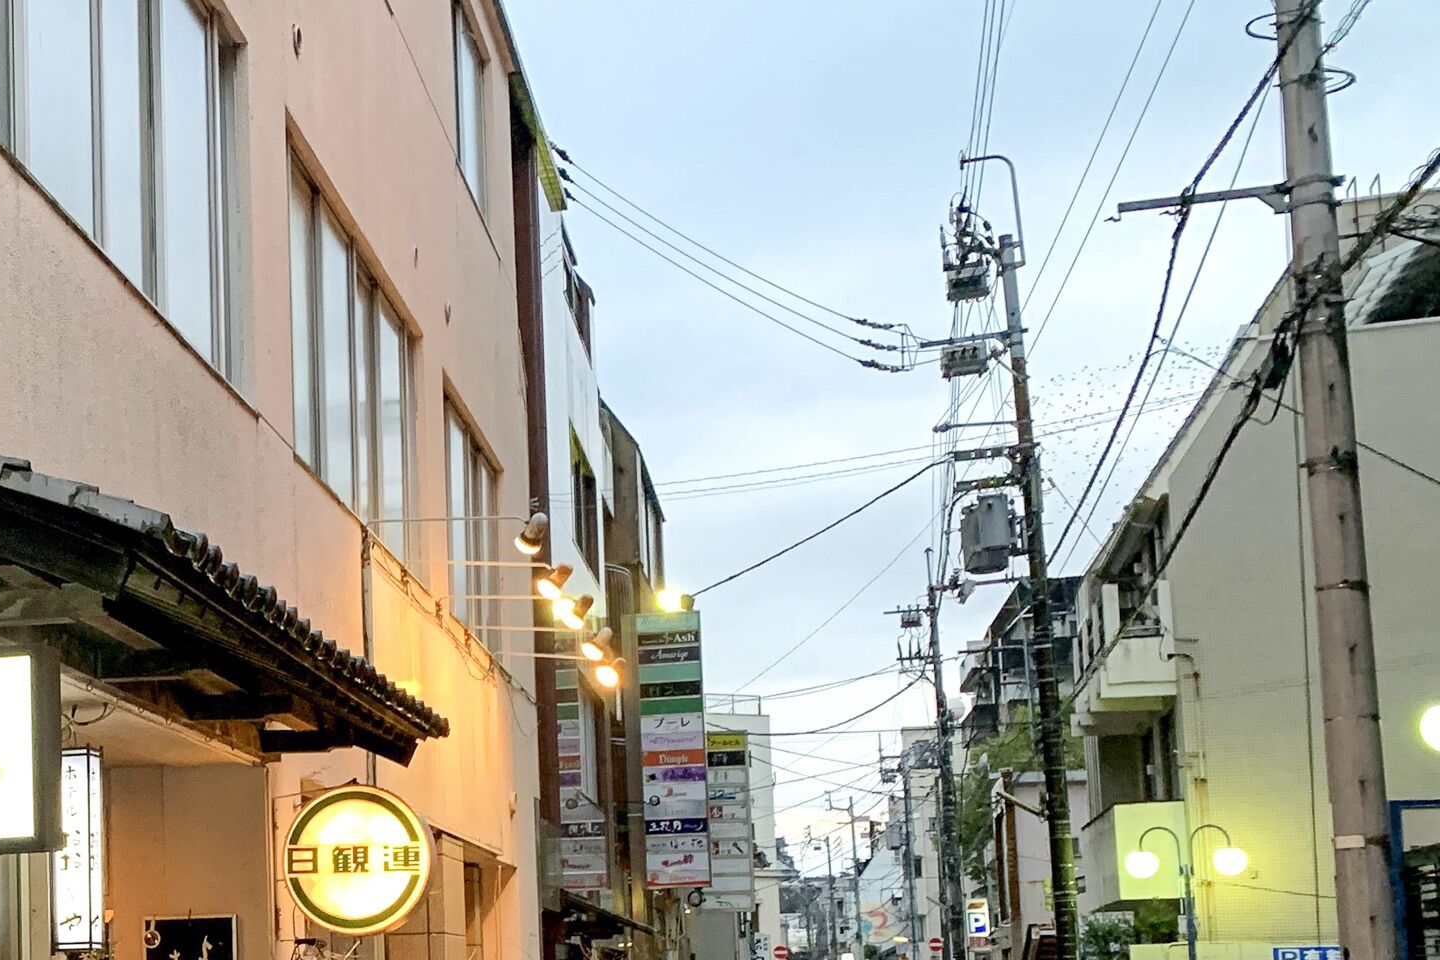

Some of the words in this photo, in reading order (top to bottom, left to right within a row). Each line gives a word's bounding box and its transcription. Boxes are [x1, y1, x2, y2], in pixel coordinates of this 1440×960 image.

[288, 845, 420, 875] 日観連
[969, 913, 986, 933] P
